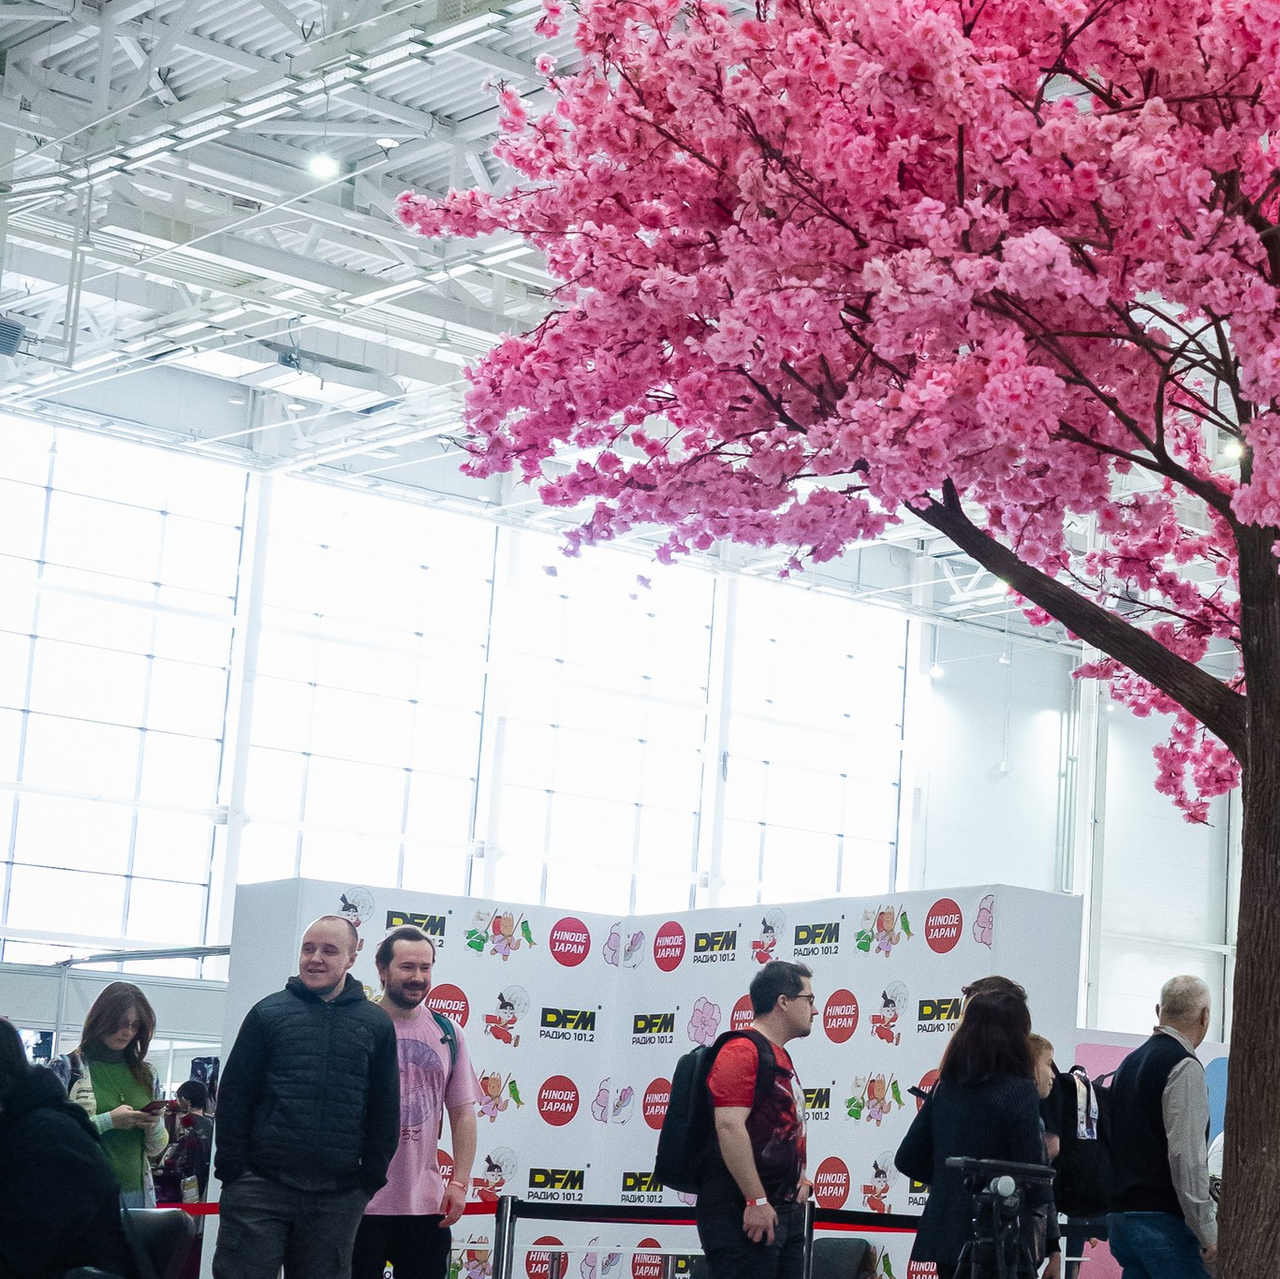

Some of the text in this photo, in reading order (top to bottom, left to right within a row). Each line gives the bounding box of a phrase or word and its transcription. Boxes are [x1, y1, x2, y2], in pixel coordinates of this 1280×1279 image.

[386, 911, 446, 936] DFM
[928, 914, 960, 926] HINODE
[552, 931, 588, 942] HINODE
[794, 923, 840, 946] DFM
[928, 927, 957, 940] JAPAN
[656, 935, 684, 947] HINODE
[694, 930, 737, 952] DFM
[552, 942, 585, 954] JAPAN
[656, 948, 681, 958] JAPAN
[793, 946, 839, 957] РАДИО 101.2
[693, 953, 736, 963] РАДИО 101.2
[428, 998, 466, 1011] HINODE
[733, 1010, 754, 1020] HINO
[826, 1004, 856, 1017] HINODE
[541, 1007, 596, 1031] DFM
[633, 1013, 675, 1034] DFM
[826, 1018, 853, 1029] JAPAN
[917, 1023, 945, 1033] РАДИО
[540, 1030, 594, 1042] РАДИО 101.2
[632, 1036, 673, 1045] РАДИО 101.2
[541, 1089, 576, 1101] HINODE
[646, 1093, 670, 1103] HINOD
[803, 1088, 830, 1109] FM
[541, 1101, 573, 1113] JAPAN
[812, 1112, 829, 1120] 101.2
[529, 1168, 585, 1190] DFM
[817, 1173, 847, 1184] HINODE
[528, 1192, 583, 1202] РАДИО 101.2
[817, 1186, 845, 1197] JAPAN
[621, 1194, 663, 1203] РАДИО 101.2
[908, 1197, 926, 1205] РАД
[634, 1254, 661, 1264] HINODE
[529, 1263, 550, 1273] JAP
[634, 1266, 659, 1276] JAPAN
[910, 1260, 937, 1272] HINOD
